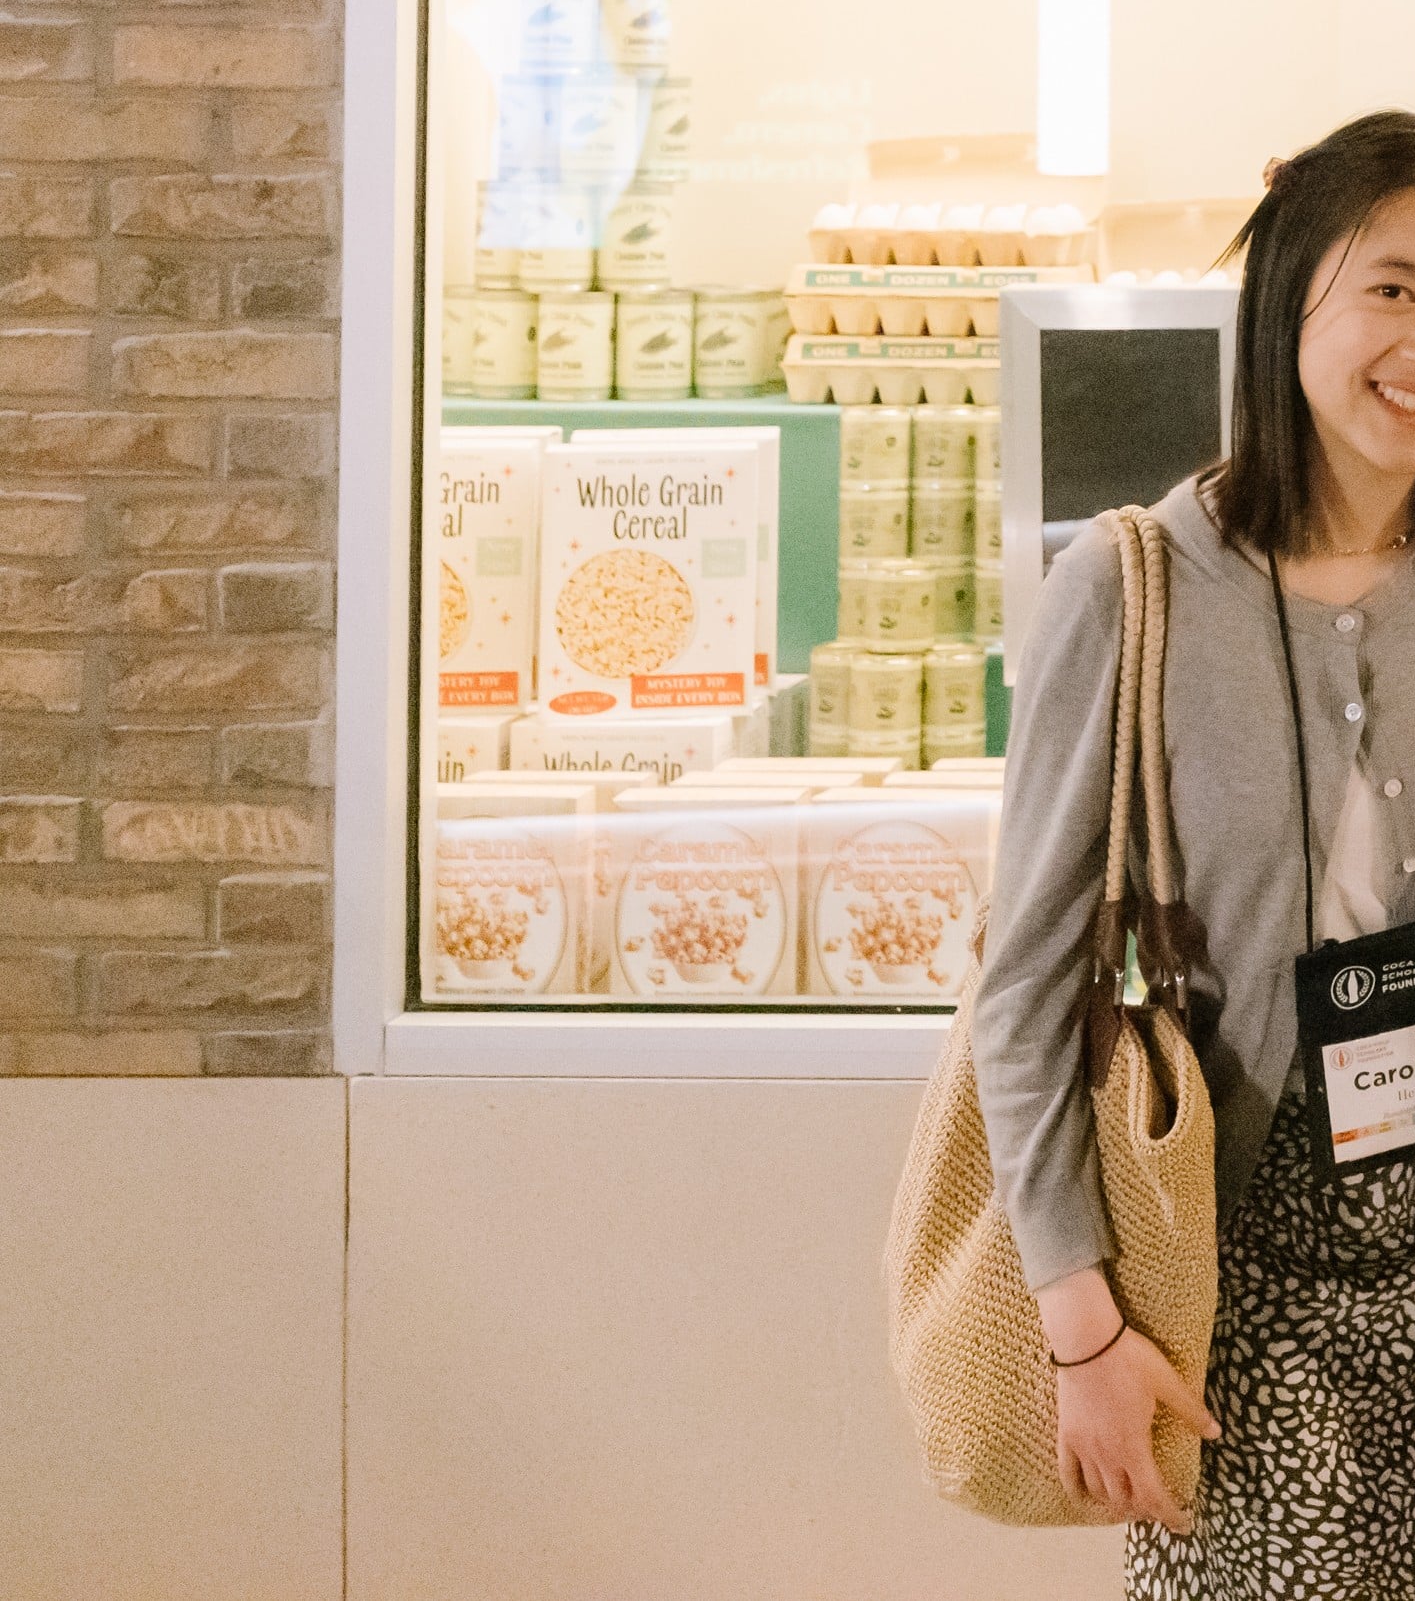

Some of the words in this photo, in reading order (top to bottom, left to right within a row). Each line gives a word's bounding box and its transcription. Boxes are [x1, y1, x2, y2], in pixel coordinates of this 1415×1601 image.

[577, 474, 650, 508] Whole
[659, 475, 724, 506] Grain
[613, 505, 688, 540] Cereal
